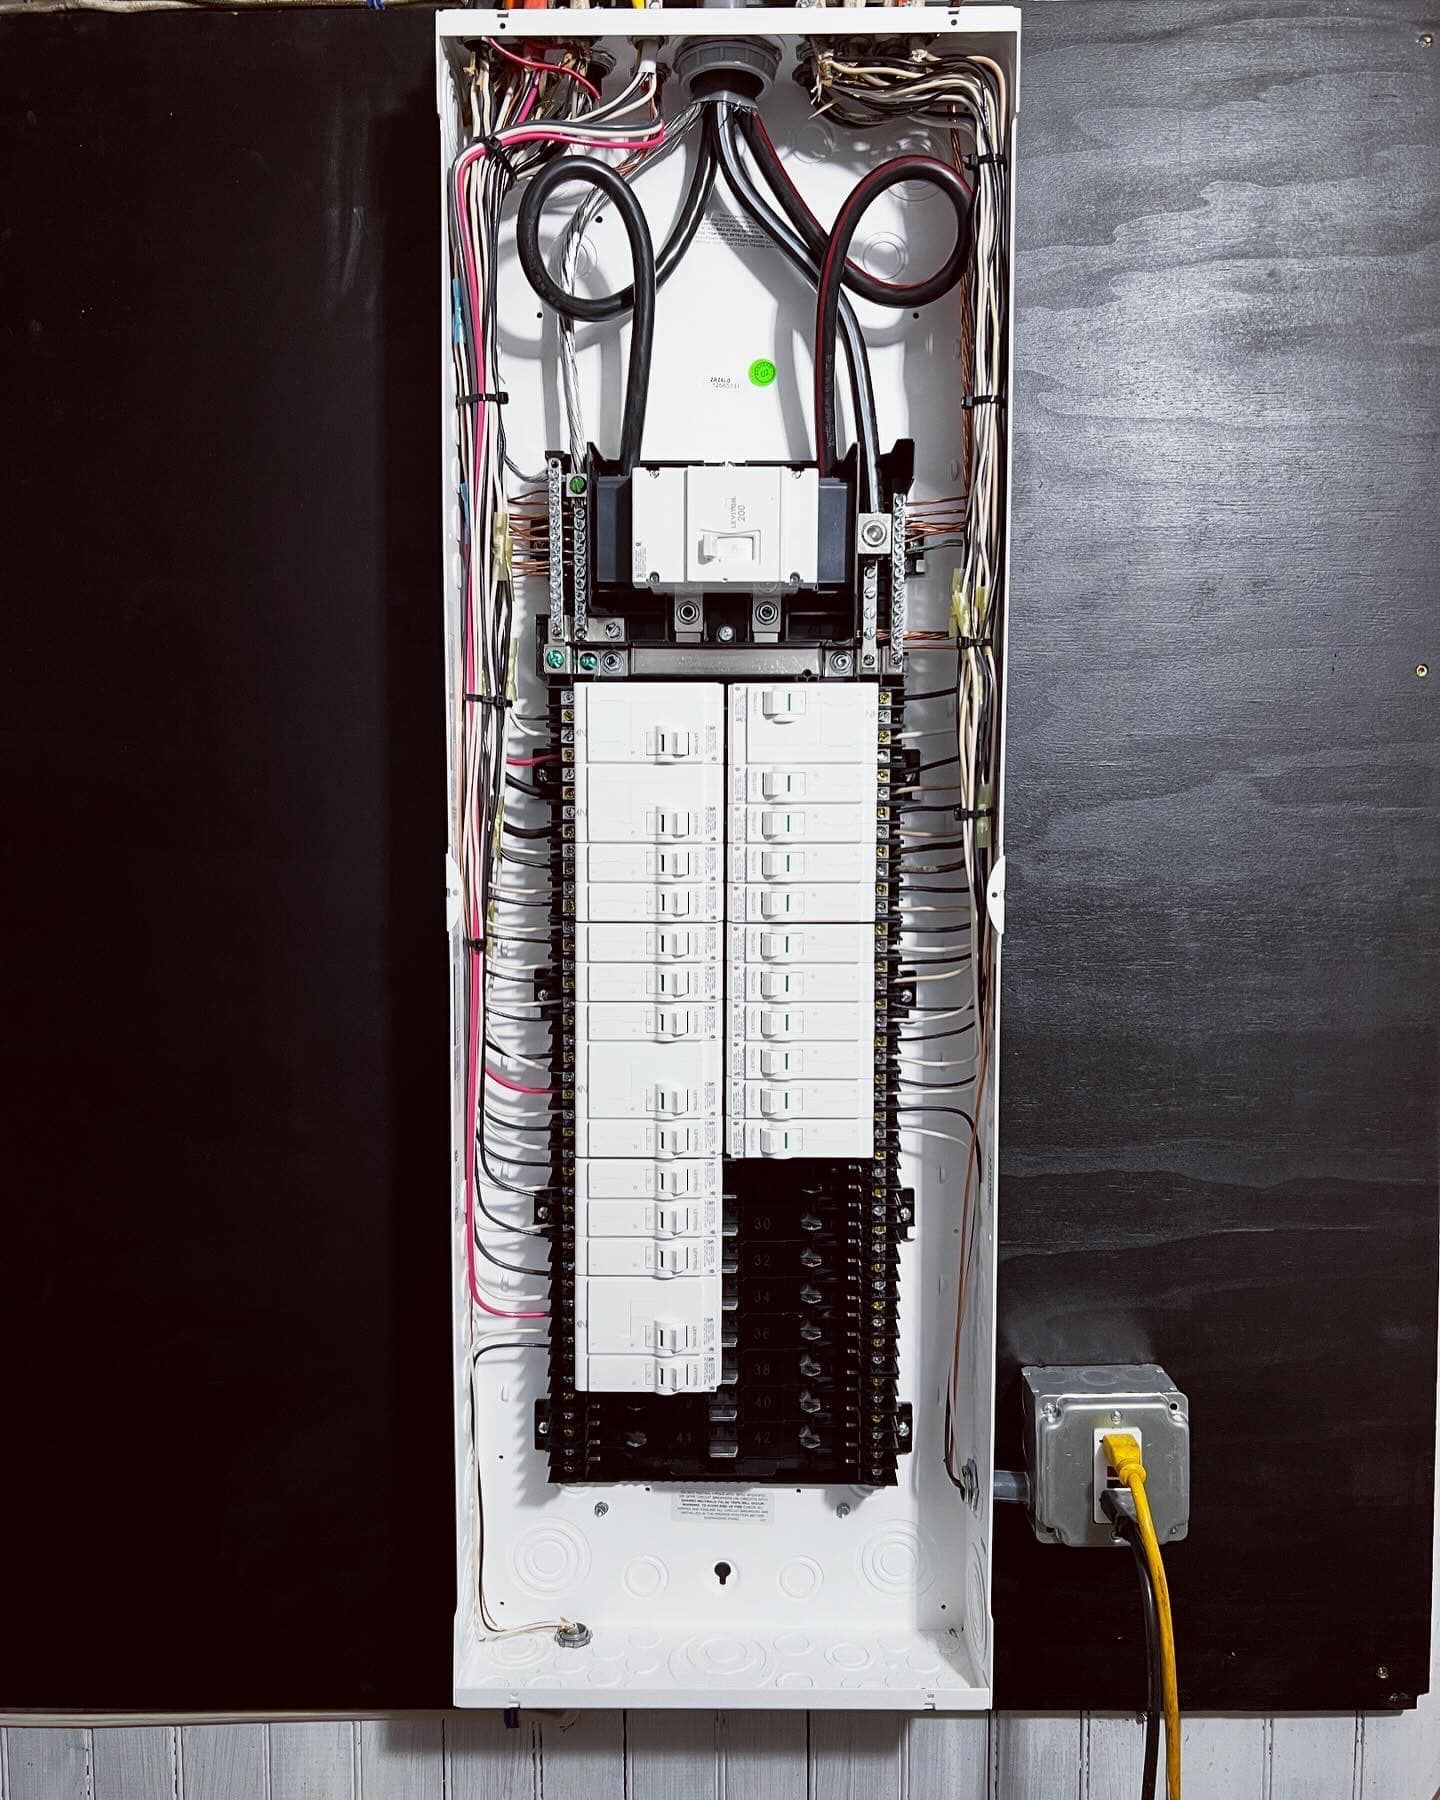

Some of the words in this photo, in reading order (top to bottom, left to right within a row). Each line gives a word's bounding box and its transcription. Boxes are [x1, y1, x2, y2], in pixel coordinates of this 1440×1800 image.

[737, 504, 746, 522] 200
[753, 1217, 771, 1231] 30
[753, 1255, 770, 1268] 32
[753, 1291, 770, 1304] 34
[753, 1363, 770, 1376] 38
[754, 1396, 771, 1409] 40
[676, 1432, 692, 1445] 41
[753, 1432, 770, 1445] 42
